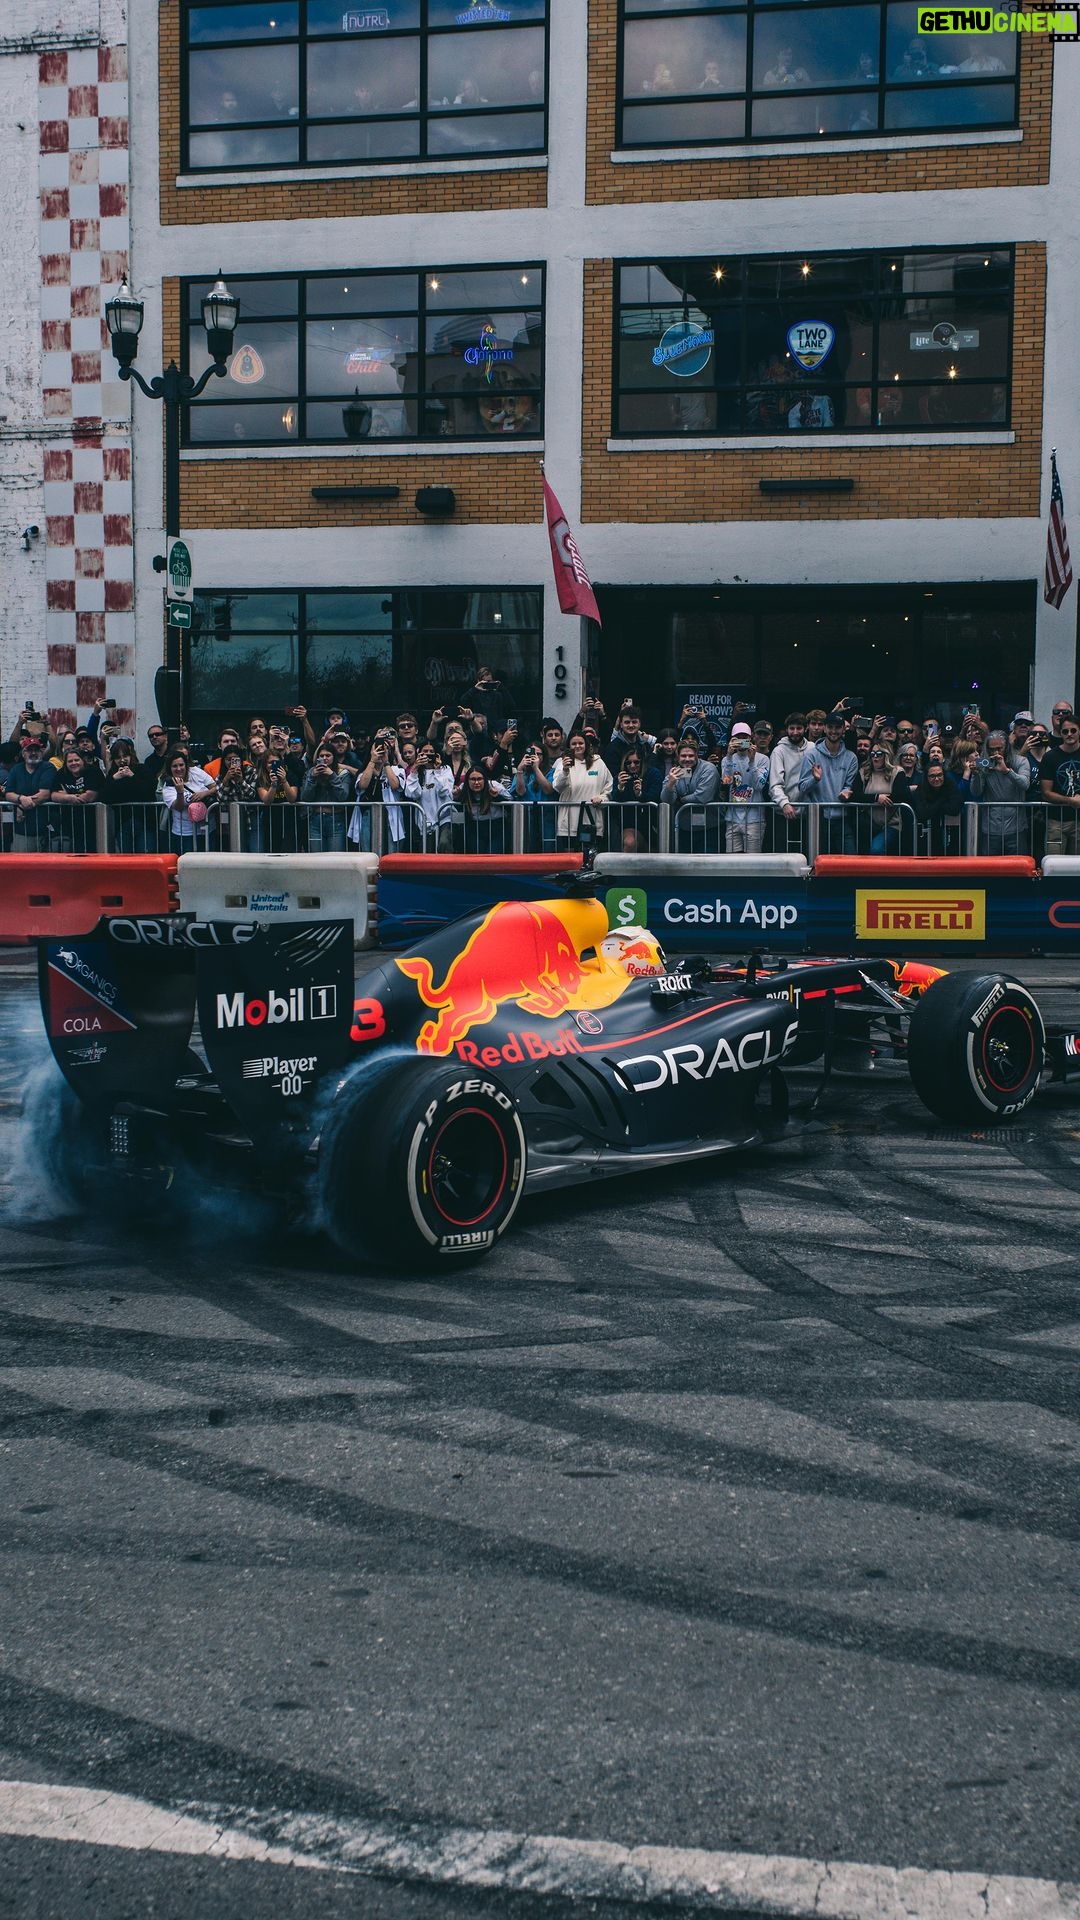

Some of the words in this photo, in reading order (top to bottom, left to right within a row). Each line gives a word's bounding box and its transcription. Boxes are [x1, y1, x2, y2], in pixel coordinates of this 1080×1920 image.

[797, 328, 827, 340] TWO
[799, 340, 824, 348] LANE
[464, 347, 513, 365] Corona
[554, 645, 567, 699] 105
[689, 694, 714, 704] READY
[717, 695, 732, 704] FOR
[704, 705, 733, 716] SHOW?
[250, 904, 288, 912] Rentals
[664, 898, 731, 923] Cash
[739, 899, 798, 929] App
[866, 900, 974, 929] PIRELLI
[216, 987, 304, 1029] Mobil
[318, 989, 327, 1015] 1
[971, 983, 1005, 1028] PIRELLI
[63, 1017, 102, 1033] COLA
[350, 997, 386, 1042] 3
[262, 1056, 317, 1077] Player
[614, 1021, 799, 1092] ORACLE
[425, 1100, 438, 1127] P
[446, 1079, 513, 1110] ZERO
[439, 1229, 494, 1253] PIRELLI
